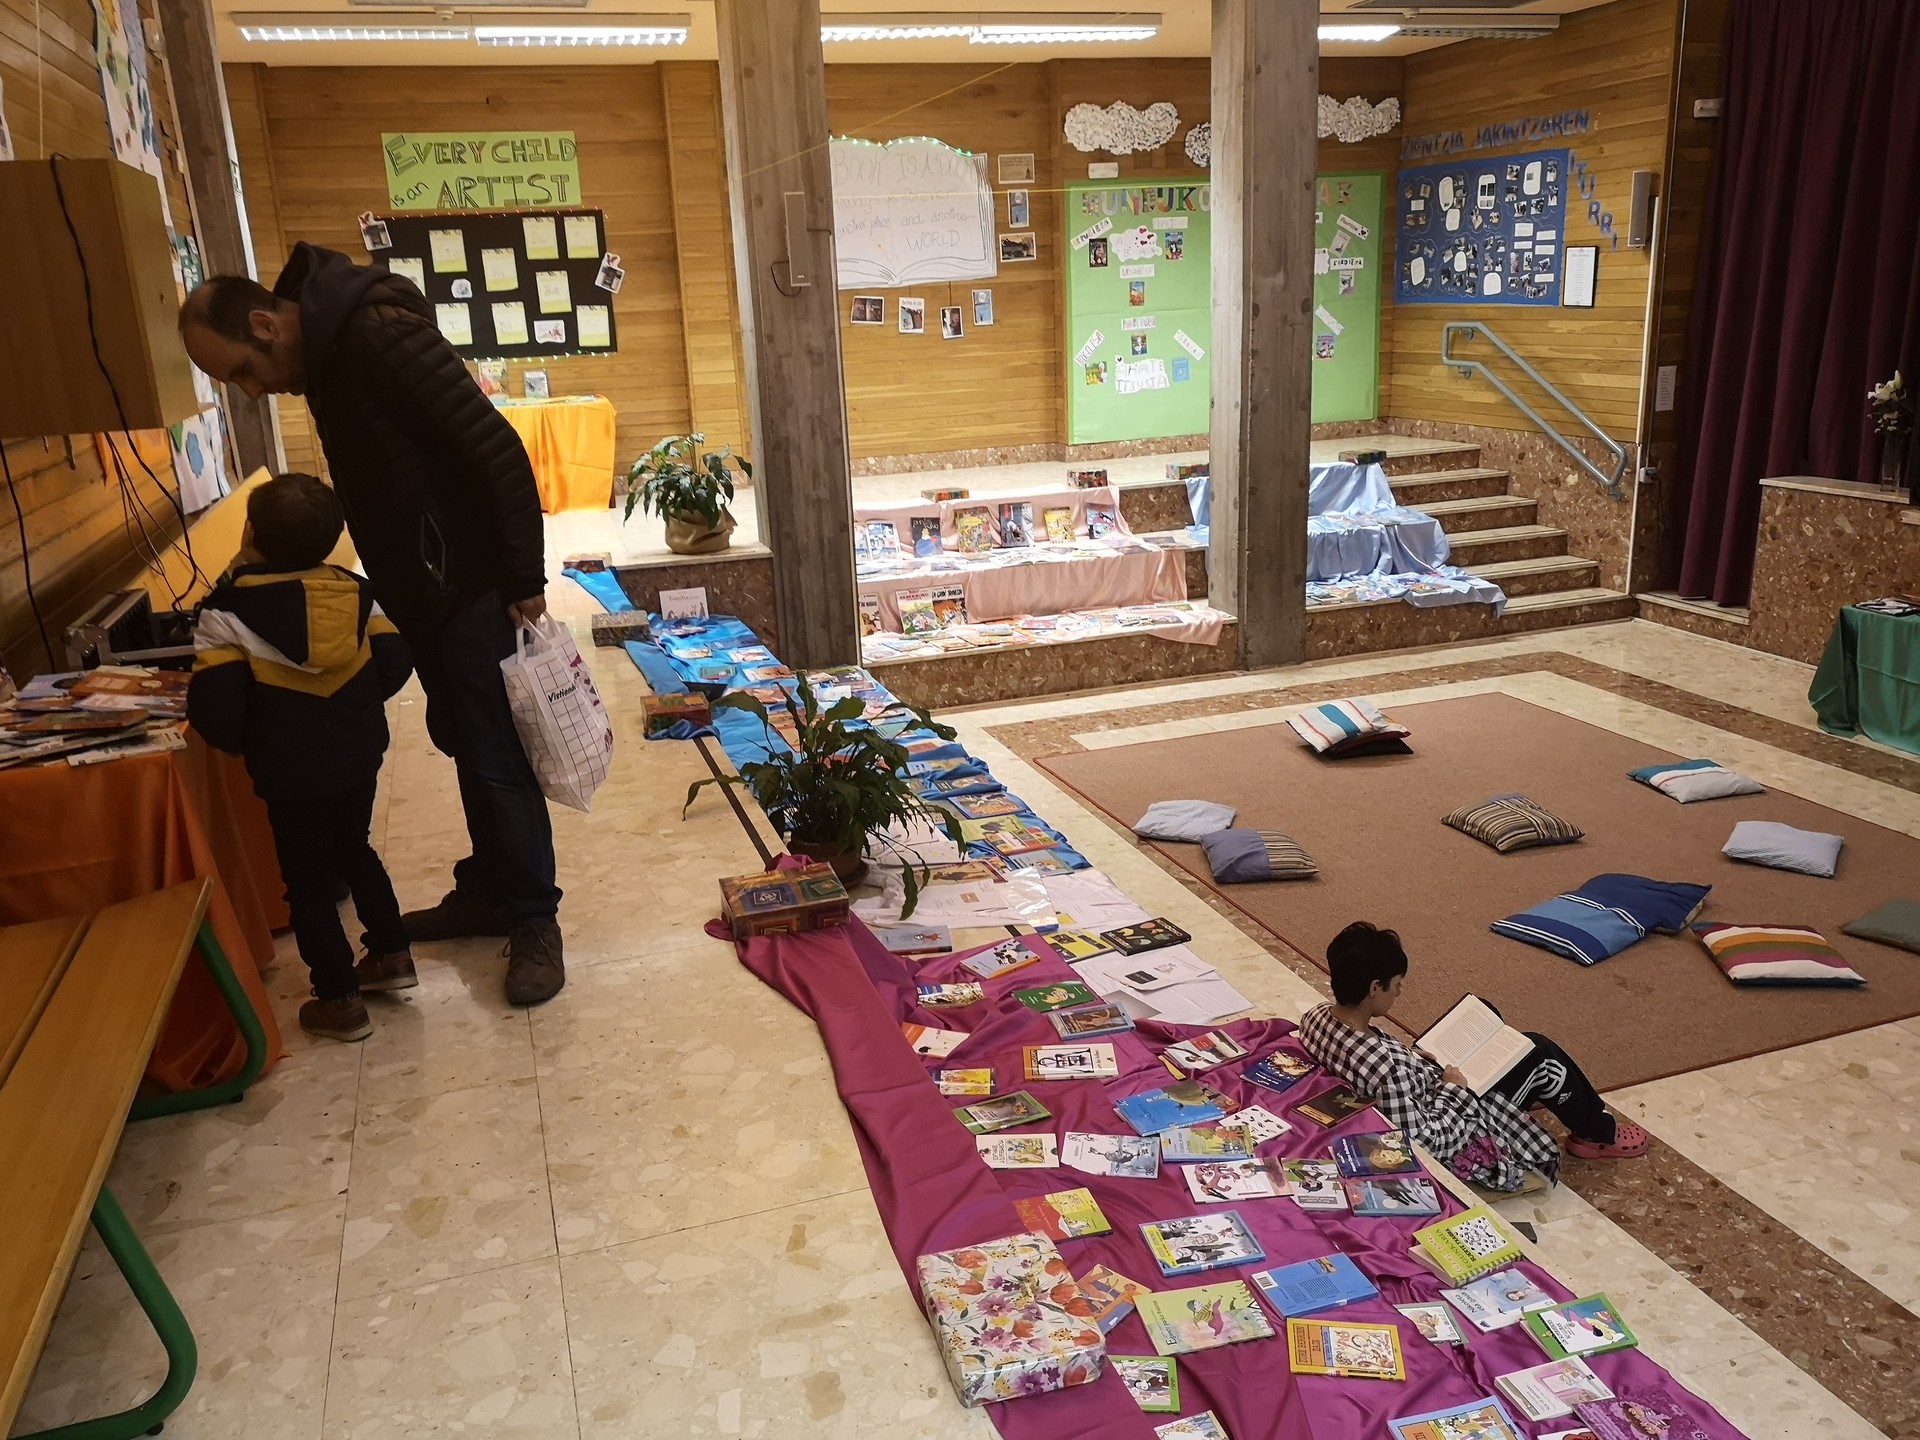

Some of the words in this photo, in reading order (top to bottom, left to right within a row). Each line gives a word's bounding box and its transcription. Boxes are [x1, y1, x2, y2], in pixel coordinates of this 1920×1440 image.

[1472, 109, 1590, 150] JAKINTZAREN
[385, 135, 486, 177] EVERY
[491, 137, 577, 163] CHILD
[407, 182, 430, 201] an
[437, 173, 570, 209] ARTIST
[900, 213, 926, 228] and
[929, 208, 975, 224] another
[906, 230, 961, 251] WORLD
[1458, 1244, 1477, 1263] SUERTE
